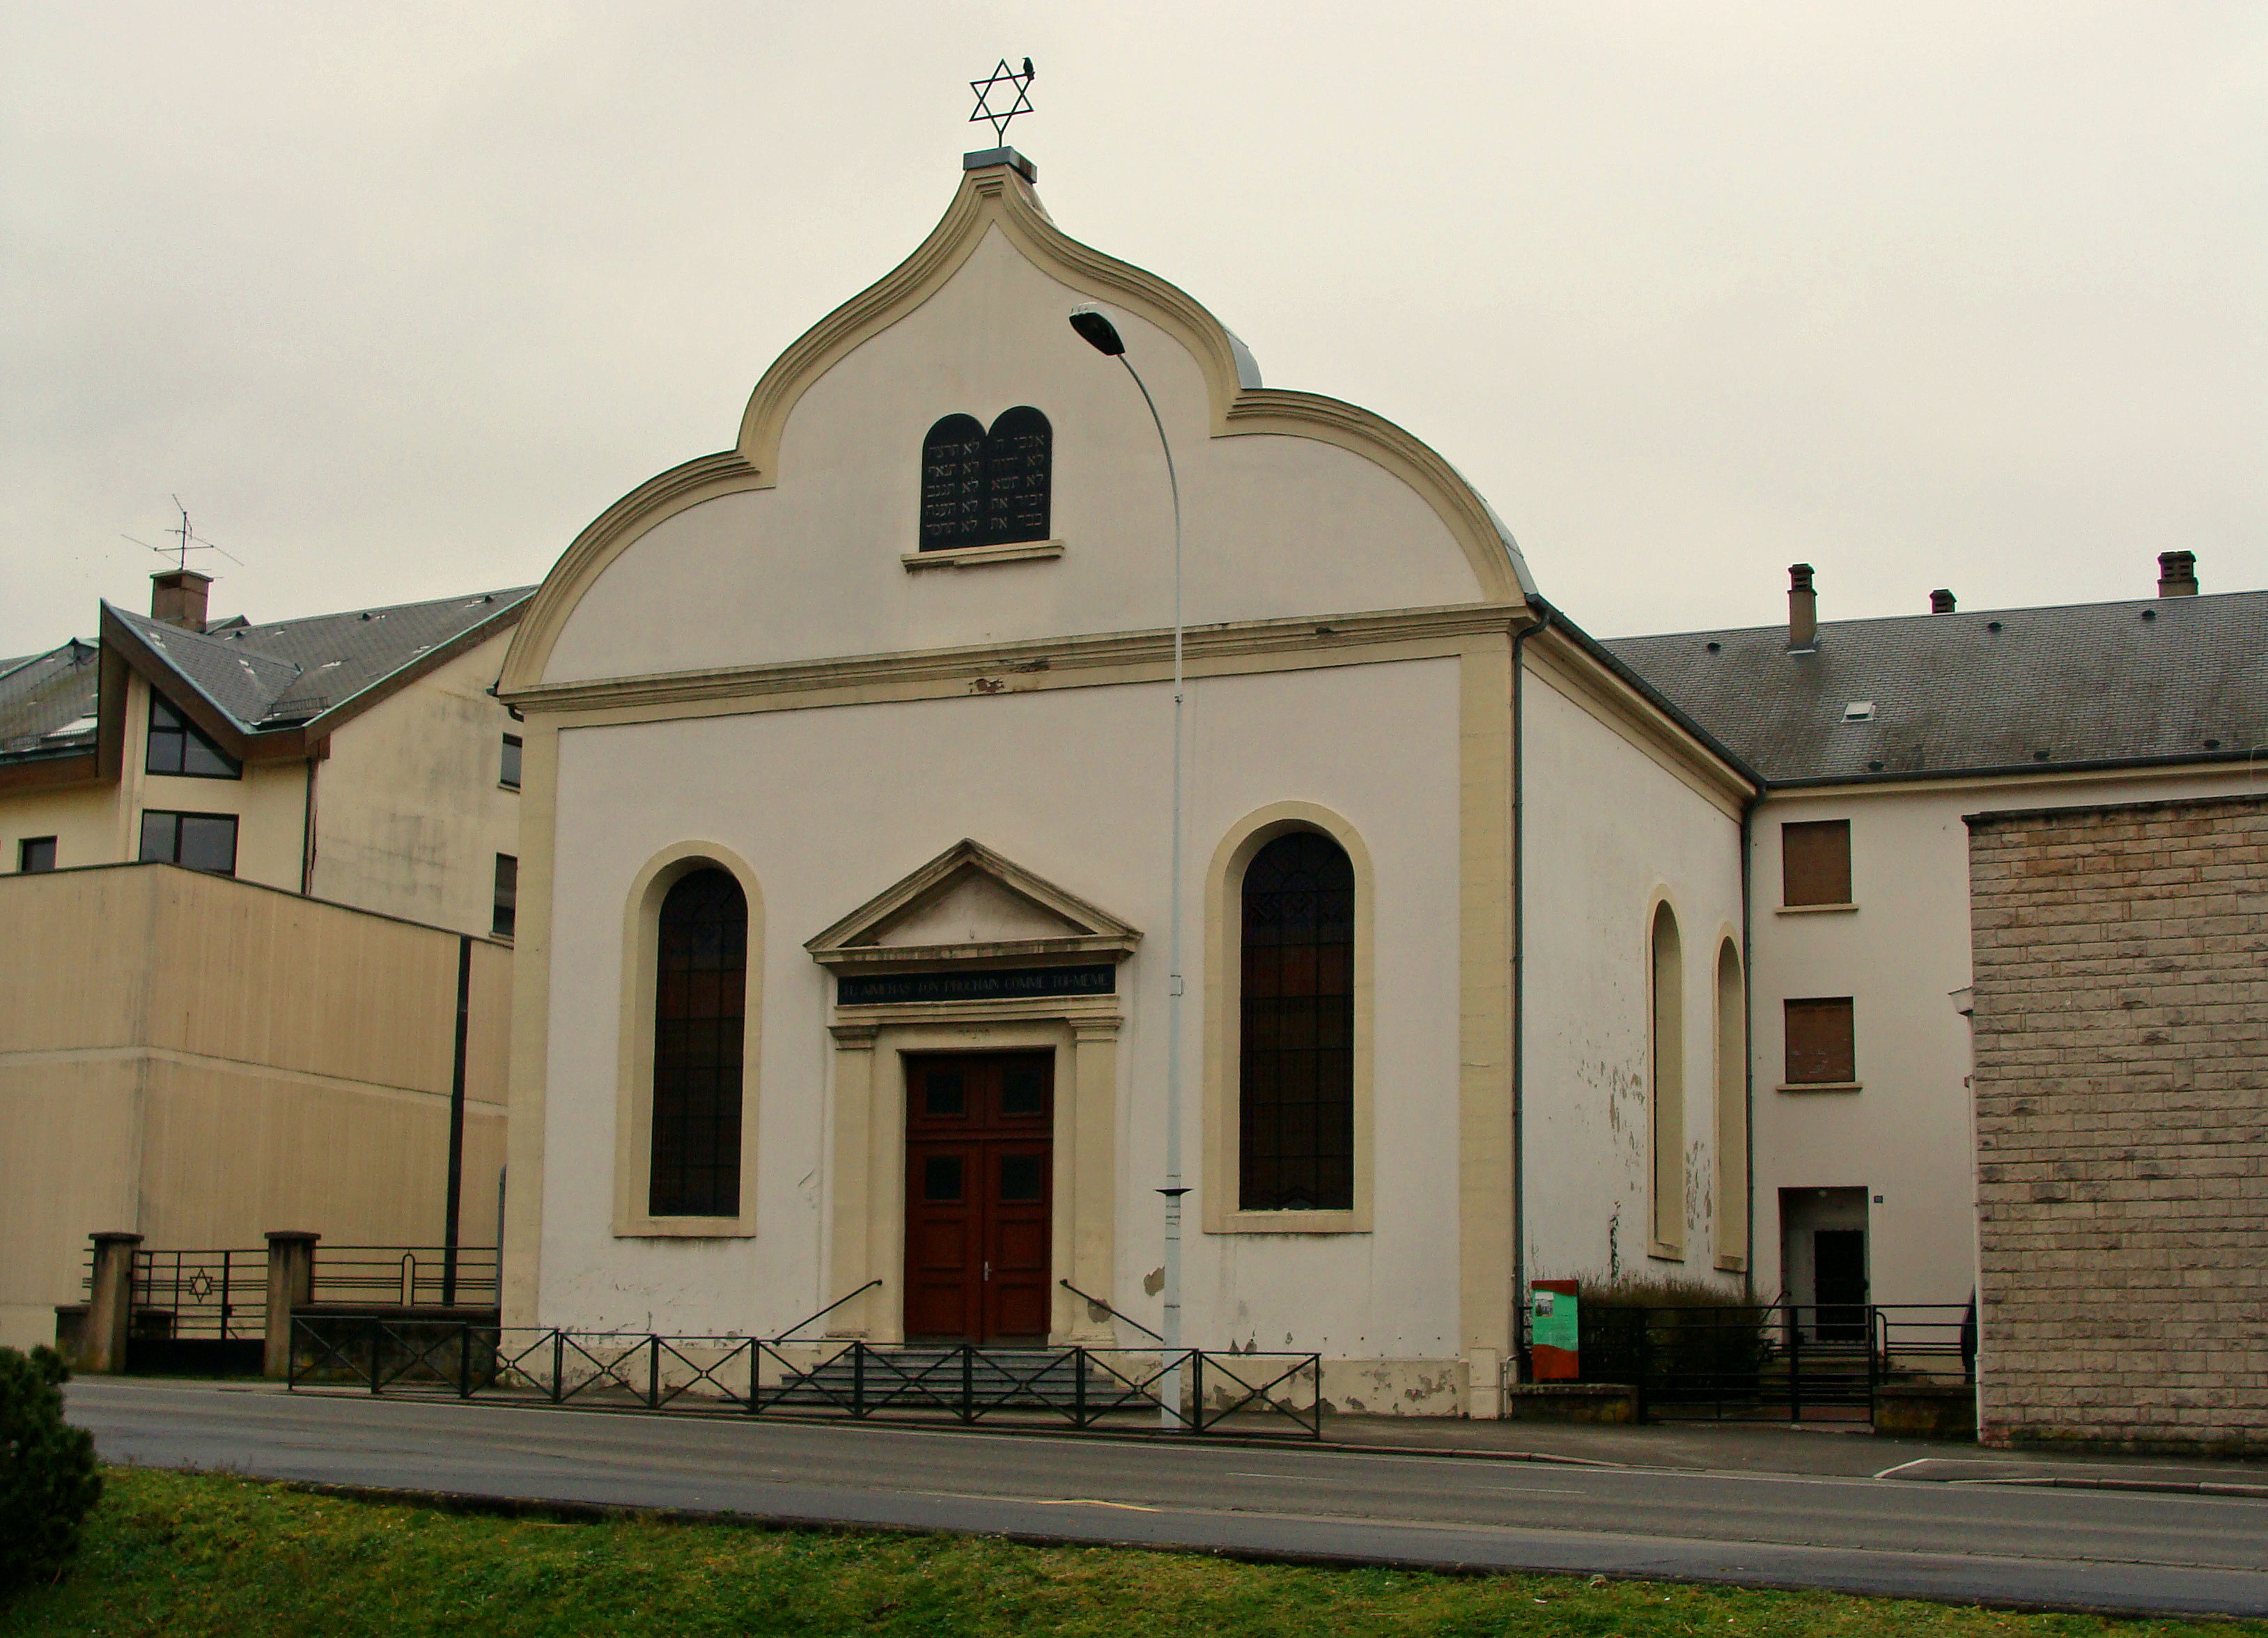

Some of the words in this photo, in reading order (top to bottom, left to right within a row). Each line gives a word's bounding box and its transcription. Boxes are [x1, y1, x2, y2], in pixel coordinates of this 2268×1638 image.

[963, 437, 981, 455] לא
[963, 458, 979, 474] לא
[1027, 453, 1045, 467] לא
[962, 476, 979, 494] לא
[1025, 469, 1044, 488] לא
[962, 496, 978, 513] לא
[991, 497, 1009, 510] את
[961, 515, 977, 533] לא
[990, 516, 1007, 530] את
